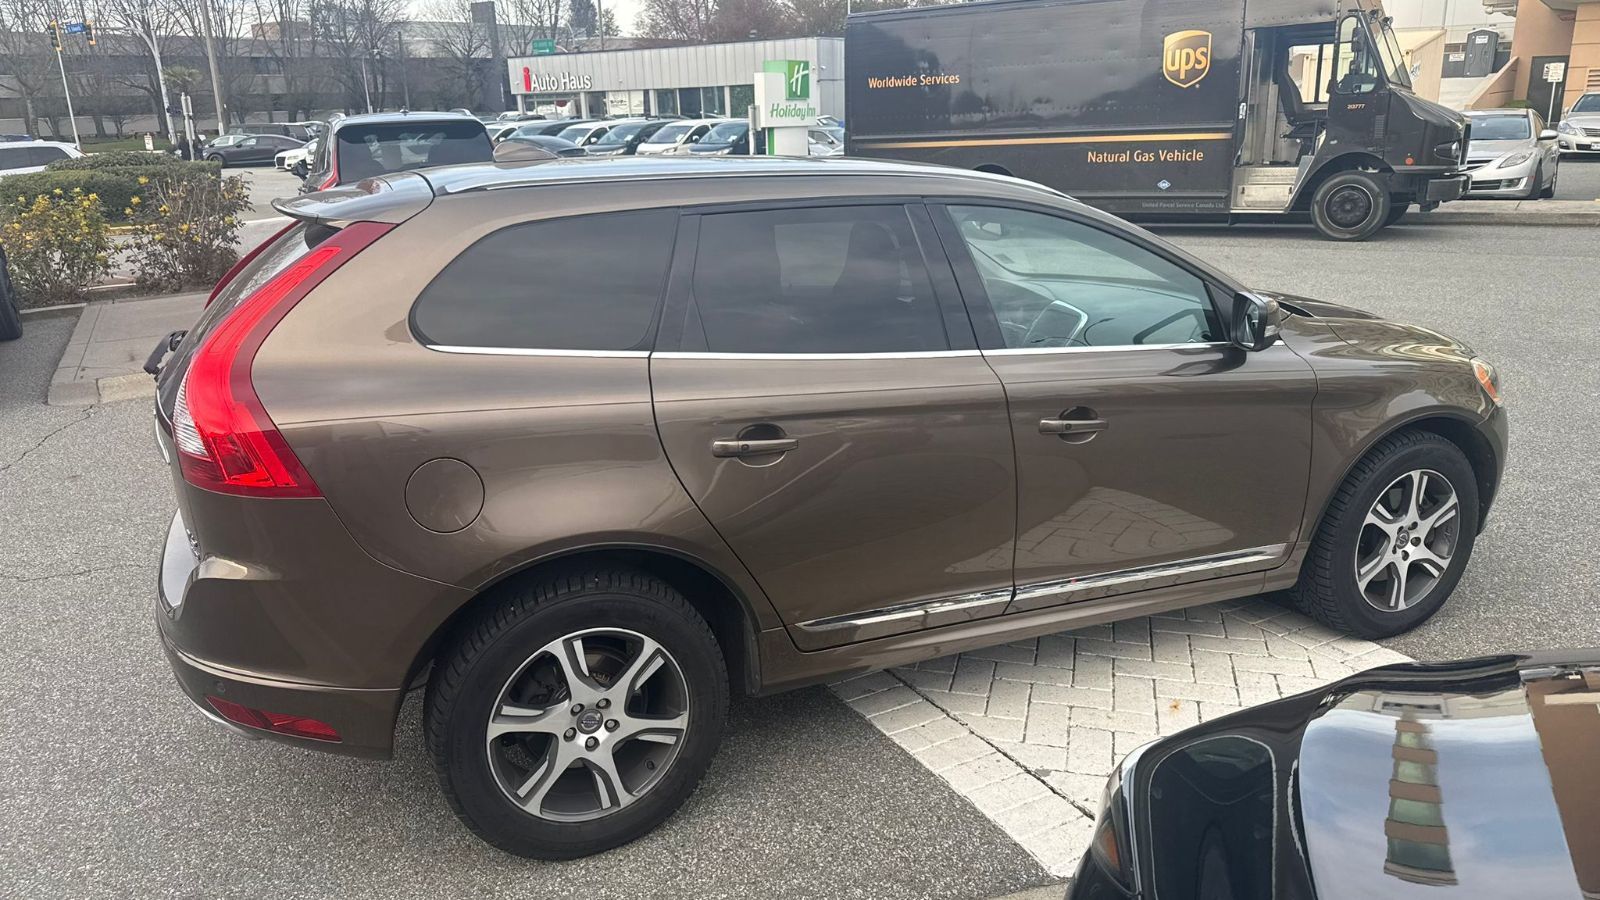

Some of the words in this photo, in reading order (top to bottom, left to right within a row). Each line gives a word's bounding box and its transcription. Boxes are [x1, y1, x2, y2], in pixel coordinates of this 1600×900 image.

[1166, 46, 1208, 80] ups
[560, 71, 592, 91] Haus
[867, 75, 917, 89] Worldwide
[919, 72, 960, 86] Services
[1087, 150, 1130, 163] Natural
[1133, 149, 1155, 162] Gas
[1158, 149, 1204, 162] Vehicle
